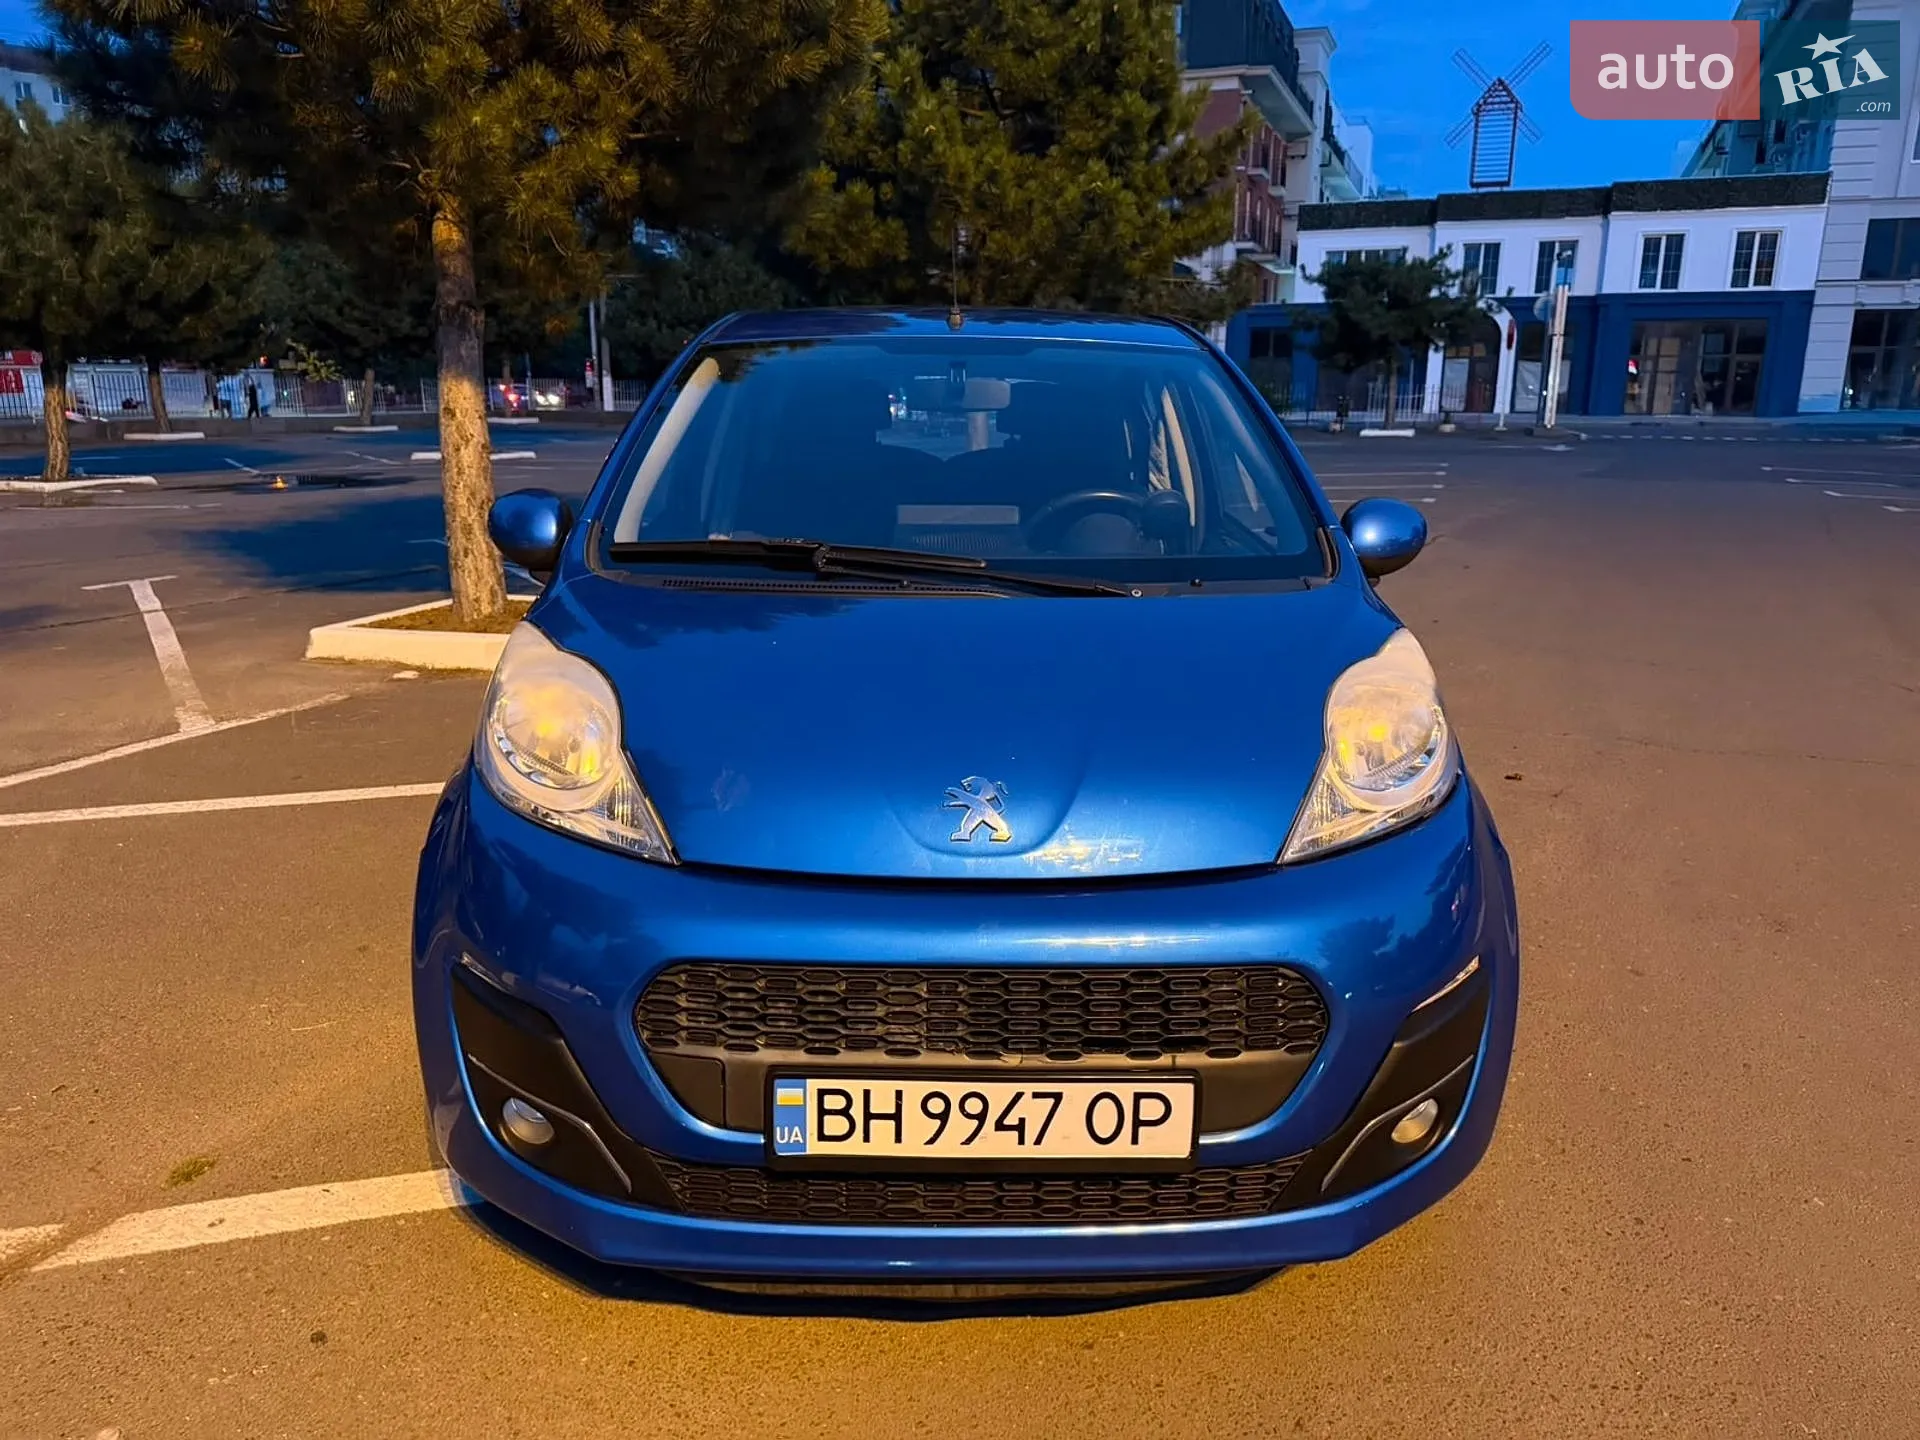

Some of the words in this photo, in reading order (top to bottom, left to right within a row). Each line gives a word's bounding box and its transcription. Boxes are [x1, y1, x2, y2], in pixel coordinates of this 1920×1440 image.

[776, 1125, 804, 1144] UA
[816, 1088, 903, 1144] BH
[920, 1090, 1064, 1146] 9947
[1084, 1091, 1173, 1146] OP
